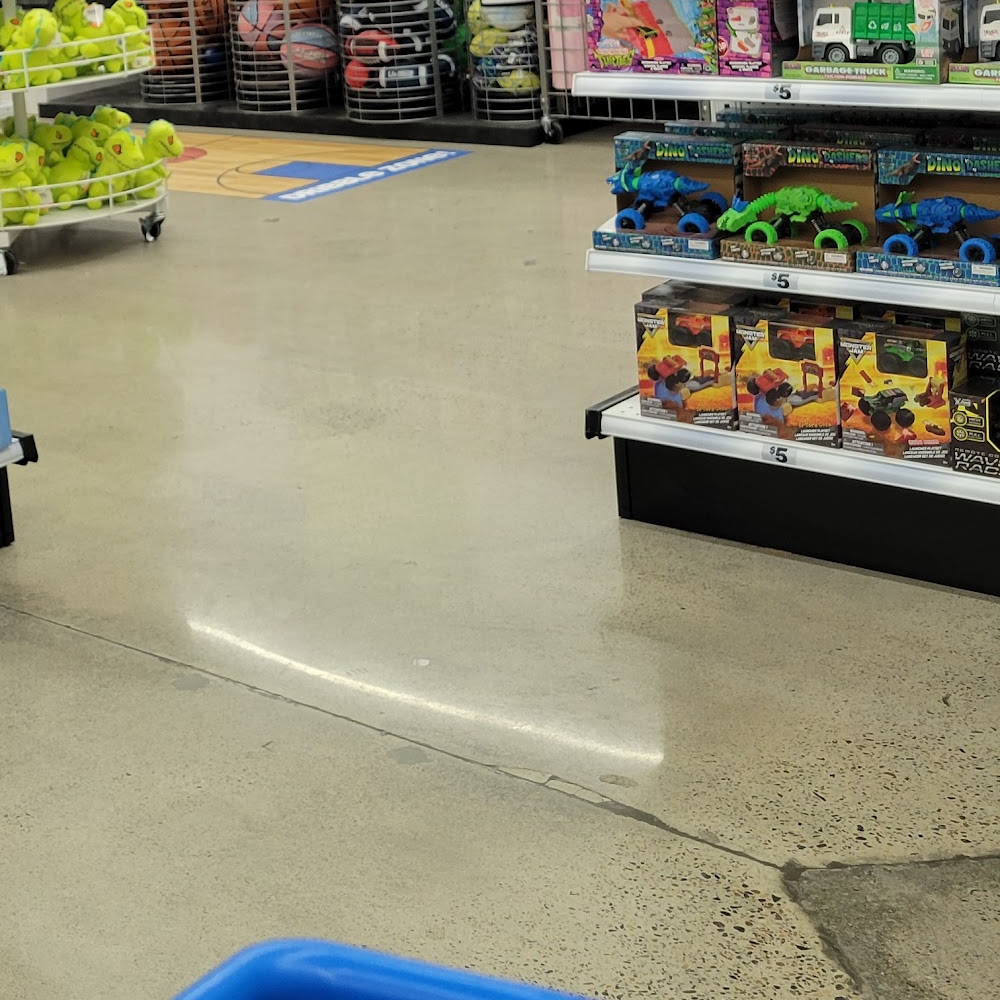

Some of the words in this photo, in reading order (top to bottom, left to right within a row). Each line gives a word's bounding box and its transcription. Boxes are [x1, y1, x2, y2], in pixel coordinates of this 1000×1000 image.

[805, 66, 854, 76] GARBAGE
[854, 67, 886, 76] TRUCK
[773, 85, 791, 100] $5
[655, 143, 685, 158] DINO
[788, 148, 819, 164] DINO
[821, 150, 870, 165] DASHERS
[925, 155, 961, 172] DINO
[964, 158, 1000, 173] DASHE
[771, 273, 790, 289] $5
[735, 328, 765, 338] MONSTER
[839, 341, 873, 351] MONSTER
[849, 347, 865, 355] JAM
[770, 445, 788, 464] $5
